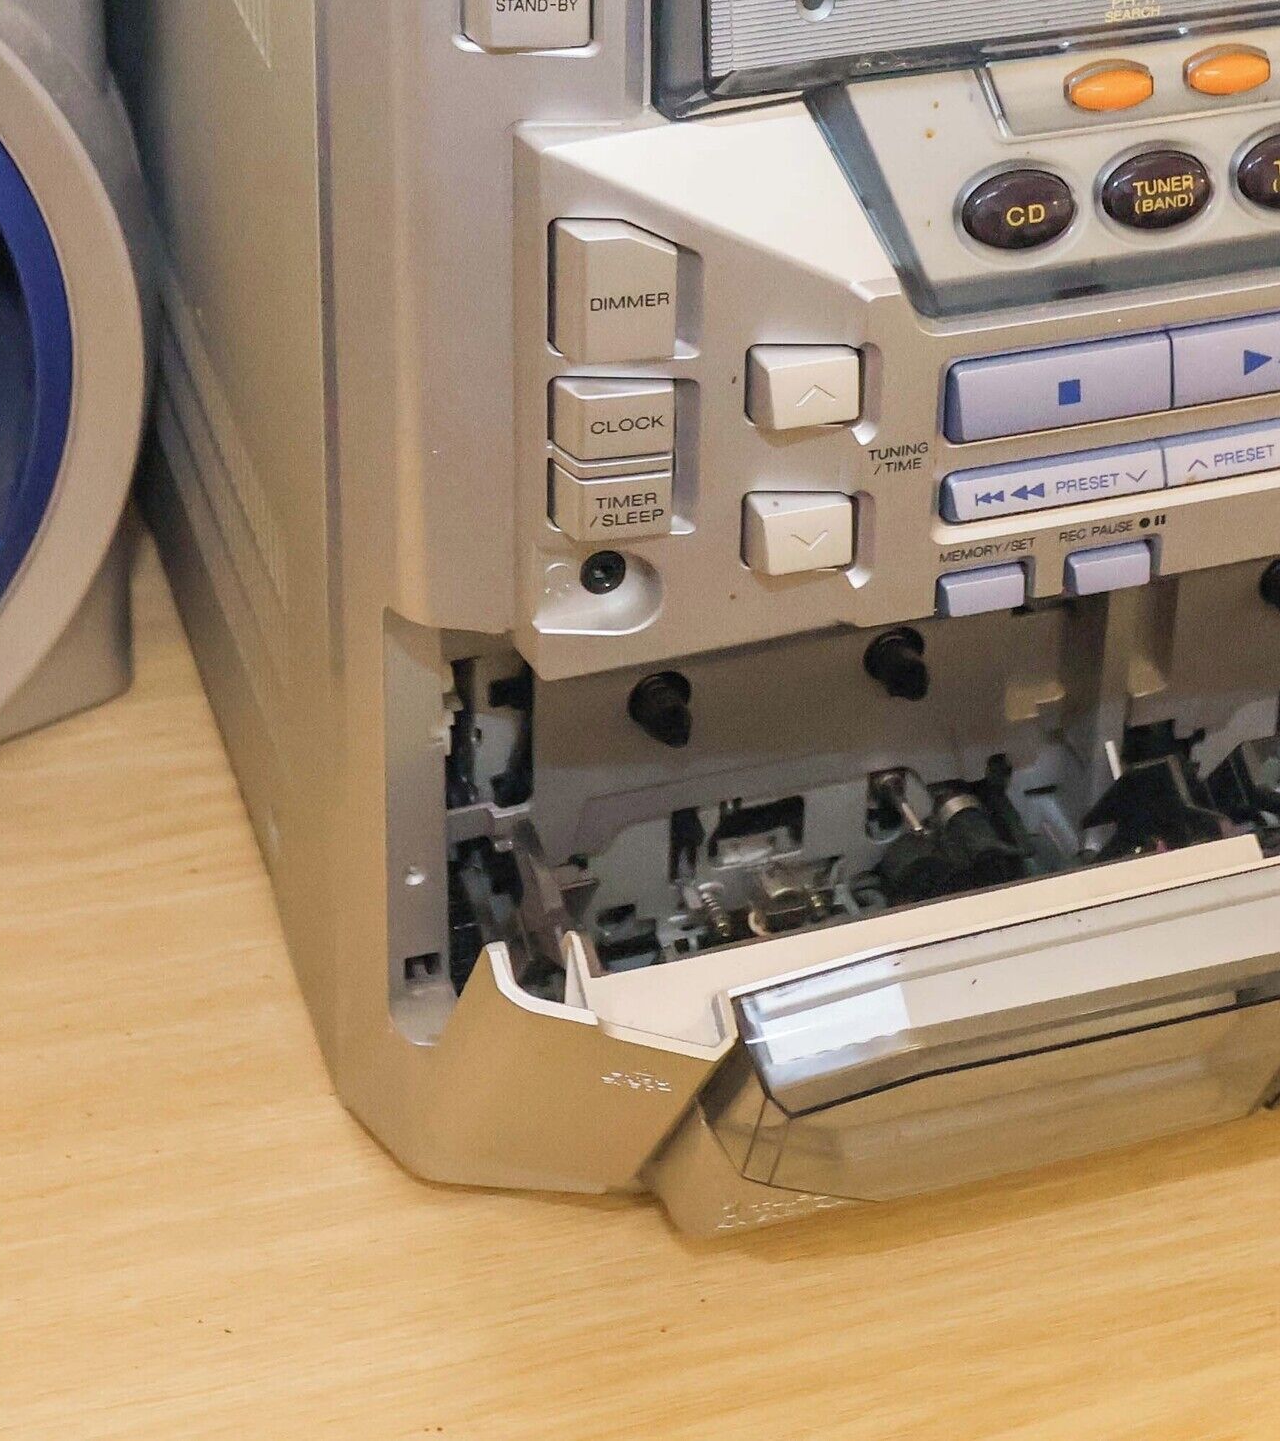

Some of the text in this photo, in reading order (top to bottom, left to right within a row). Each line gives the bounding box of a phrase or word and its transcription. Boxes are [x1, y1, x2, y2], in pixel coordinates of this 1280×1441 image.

[1105, 4, 1161, 24] SEARCH
[1132, 174, 1195, 197] TUNER
[1135, 192, 1195, 215] (BAND)
[1006, 204, 1046, 227] CD
[590, 292, 670, 311] DIMMER
[590, 415, 665, 435] CLOCK
[868, 441, 929, 461] TUNING
[1213, 444, 1276, 467] PRESET
[873, 458, 922, 476] /TIME
[1055, 472, 1120, 495] PRESET
[596, 492, 658, 510] TIMER
[589, 508, 664, 529] /SLEEP
[1058, 518, 1134, 544] REC PAUSE
[939, 536, 1037, 565] MEMORY/SET
